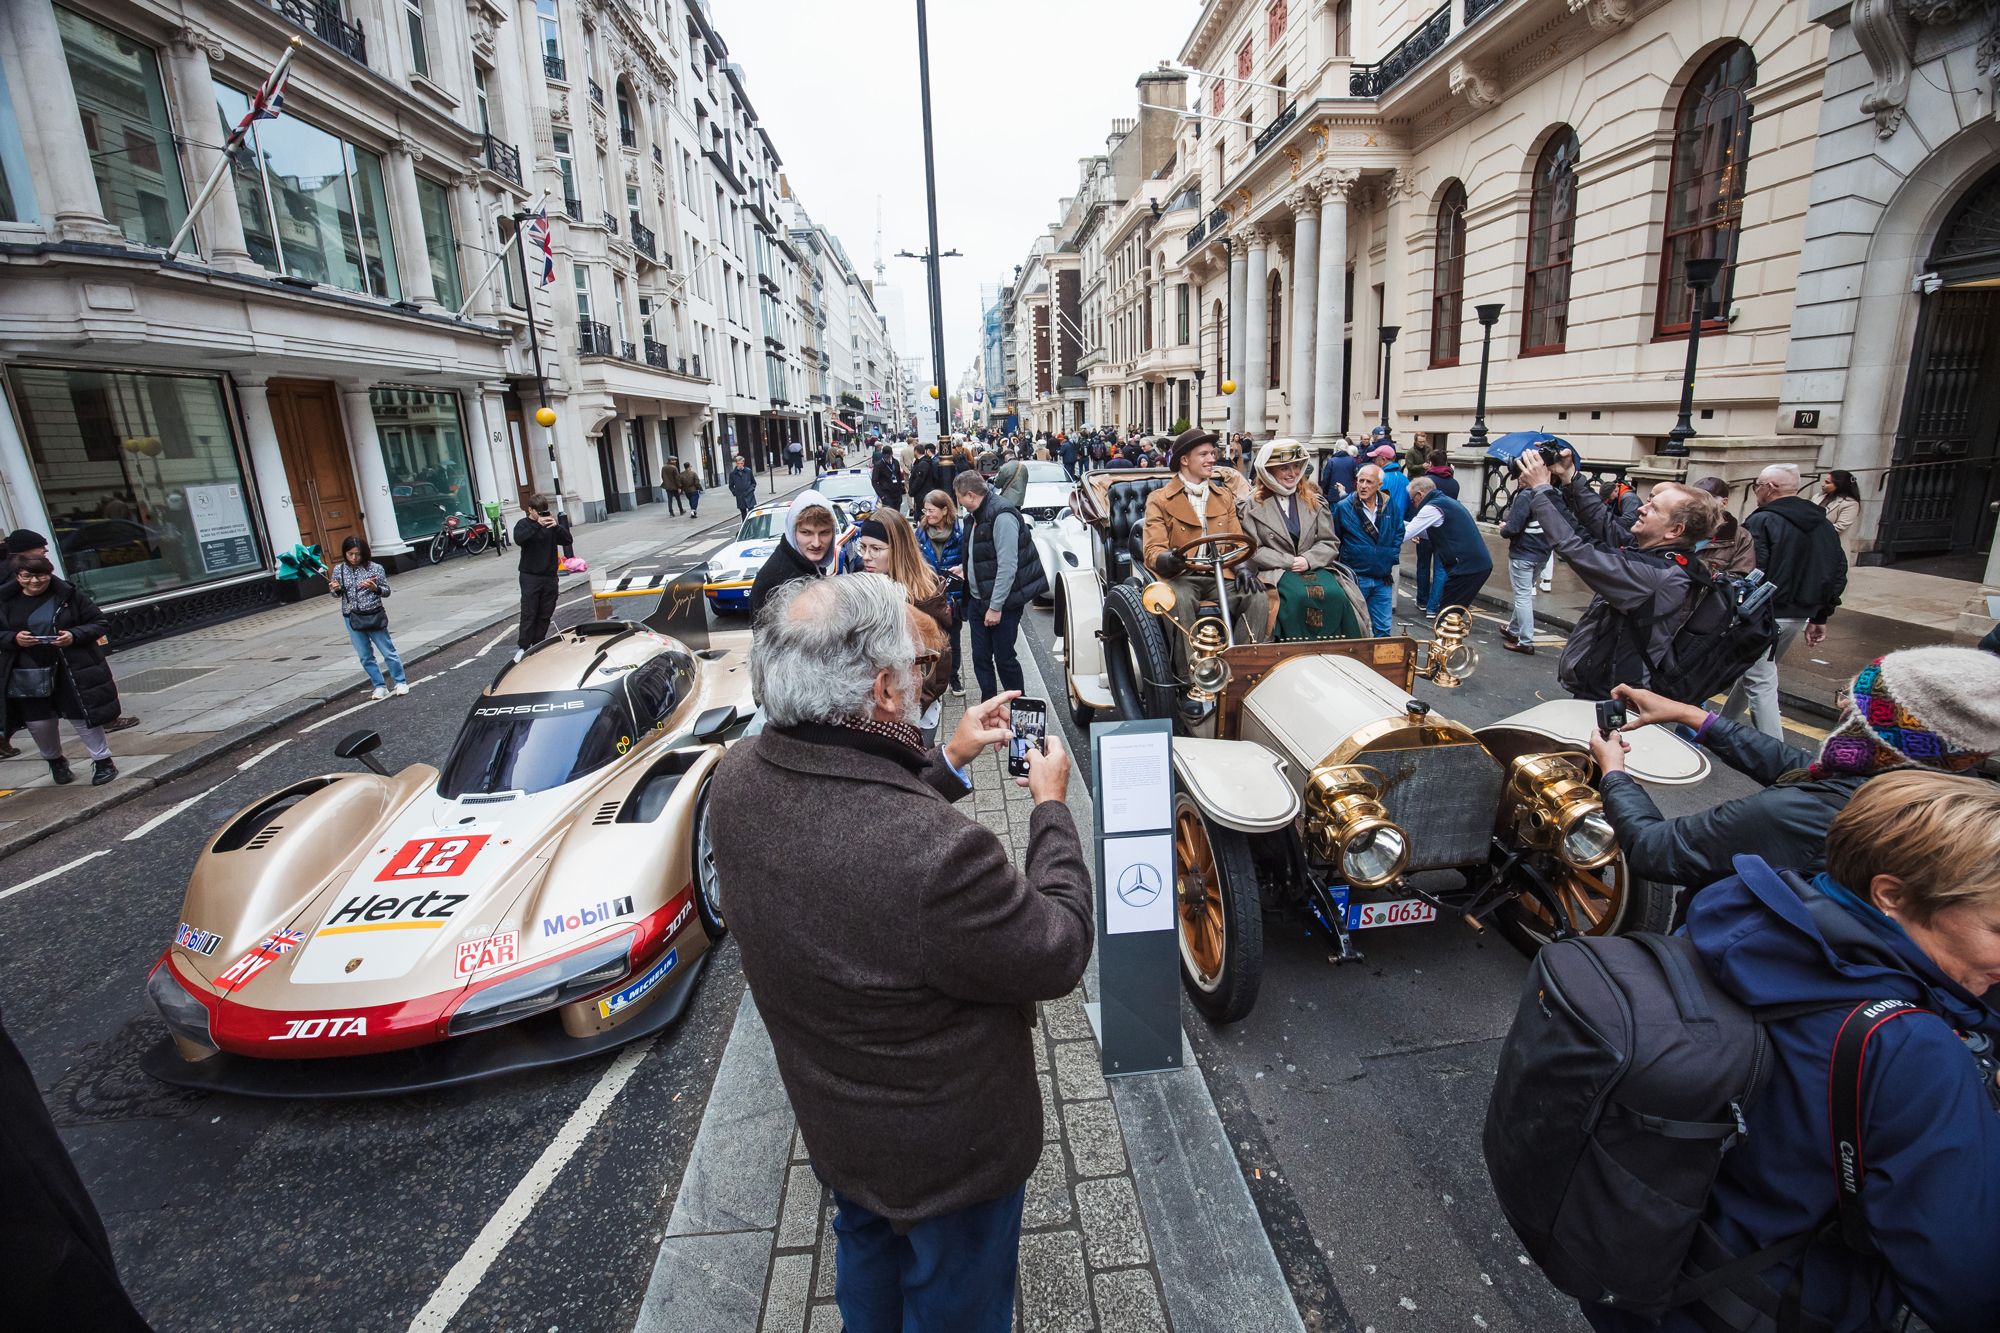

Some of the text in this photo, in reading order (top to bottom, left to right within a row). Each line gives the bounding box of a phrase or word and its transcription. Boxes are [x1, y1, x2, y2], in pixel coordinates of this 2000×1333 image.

[1801, 412, 1813, 424] 70
[493, 431, 502, 443] 50
[474, 700, 585, 717] PORSCHE
[392, 838, 470, 877] 12
[327, 890, 470, 926] Hertz
[543, 902, 610, 937] Mobil
[662, 900, 693, 943] JOTA
[1361, 906, 1374, 925] S
[1387, 901, 1432, 923] 0631
[175, 922, 210, 952] Mobil
[460, 934, 513, 956] HYPER
[459, 945, 514, 973] CAR
[628, 957, 673, 1001] MICHELIN
[268, 1017, 367, 1041] JOTA
[1839, 1140, 1858, 1194] Canon
